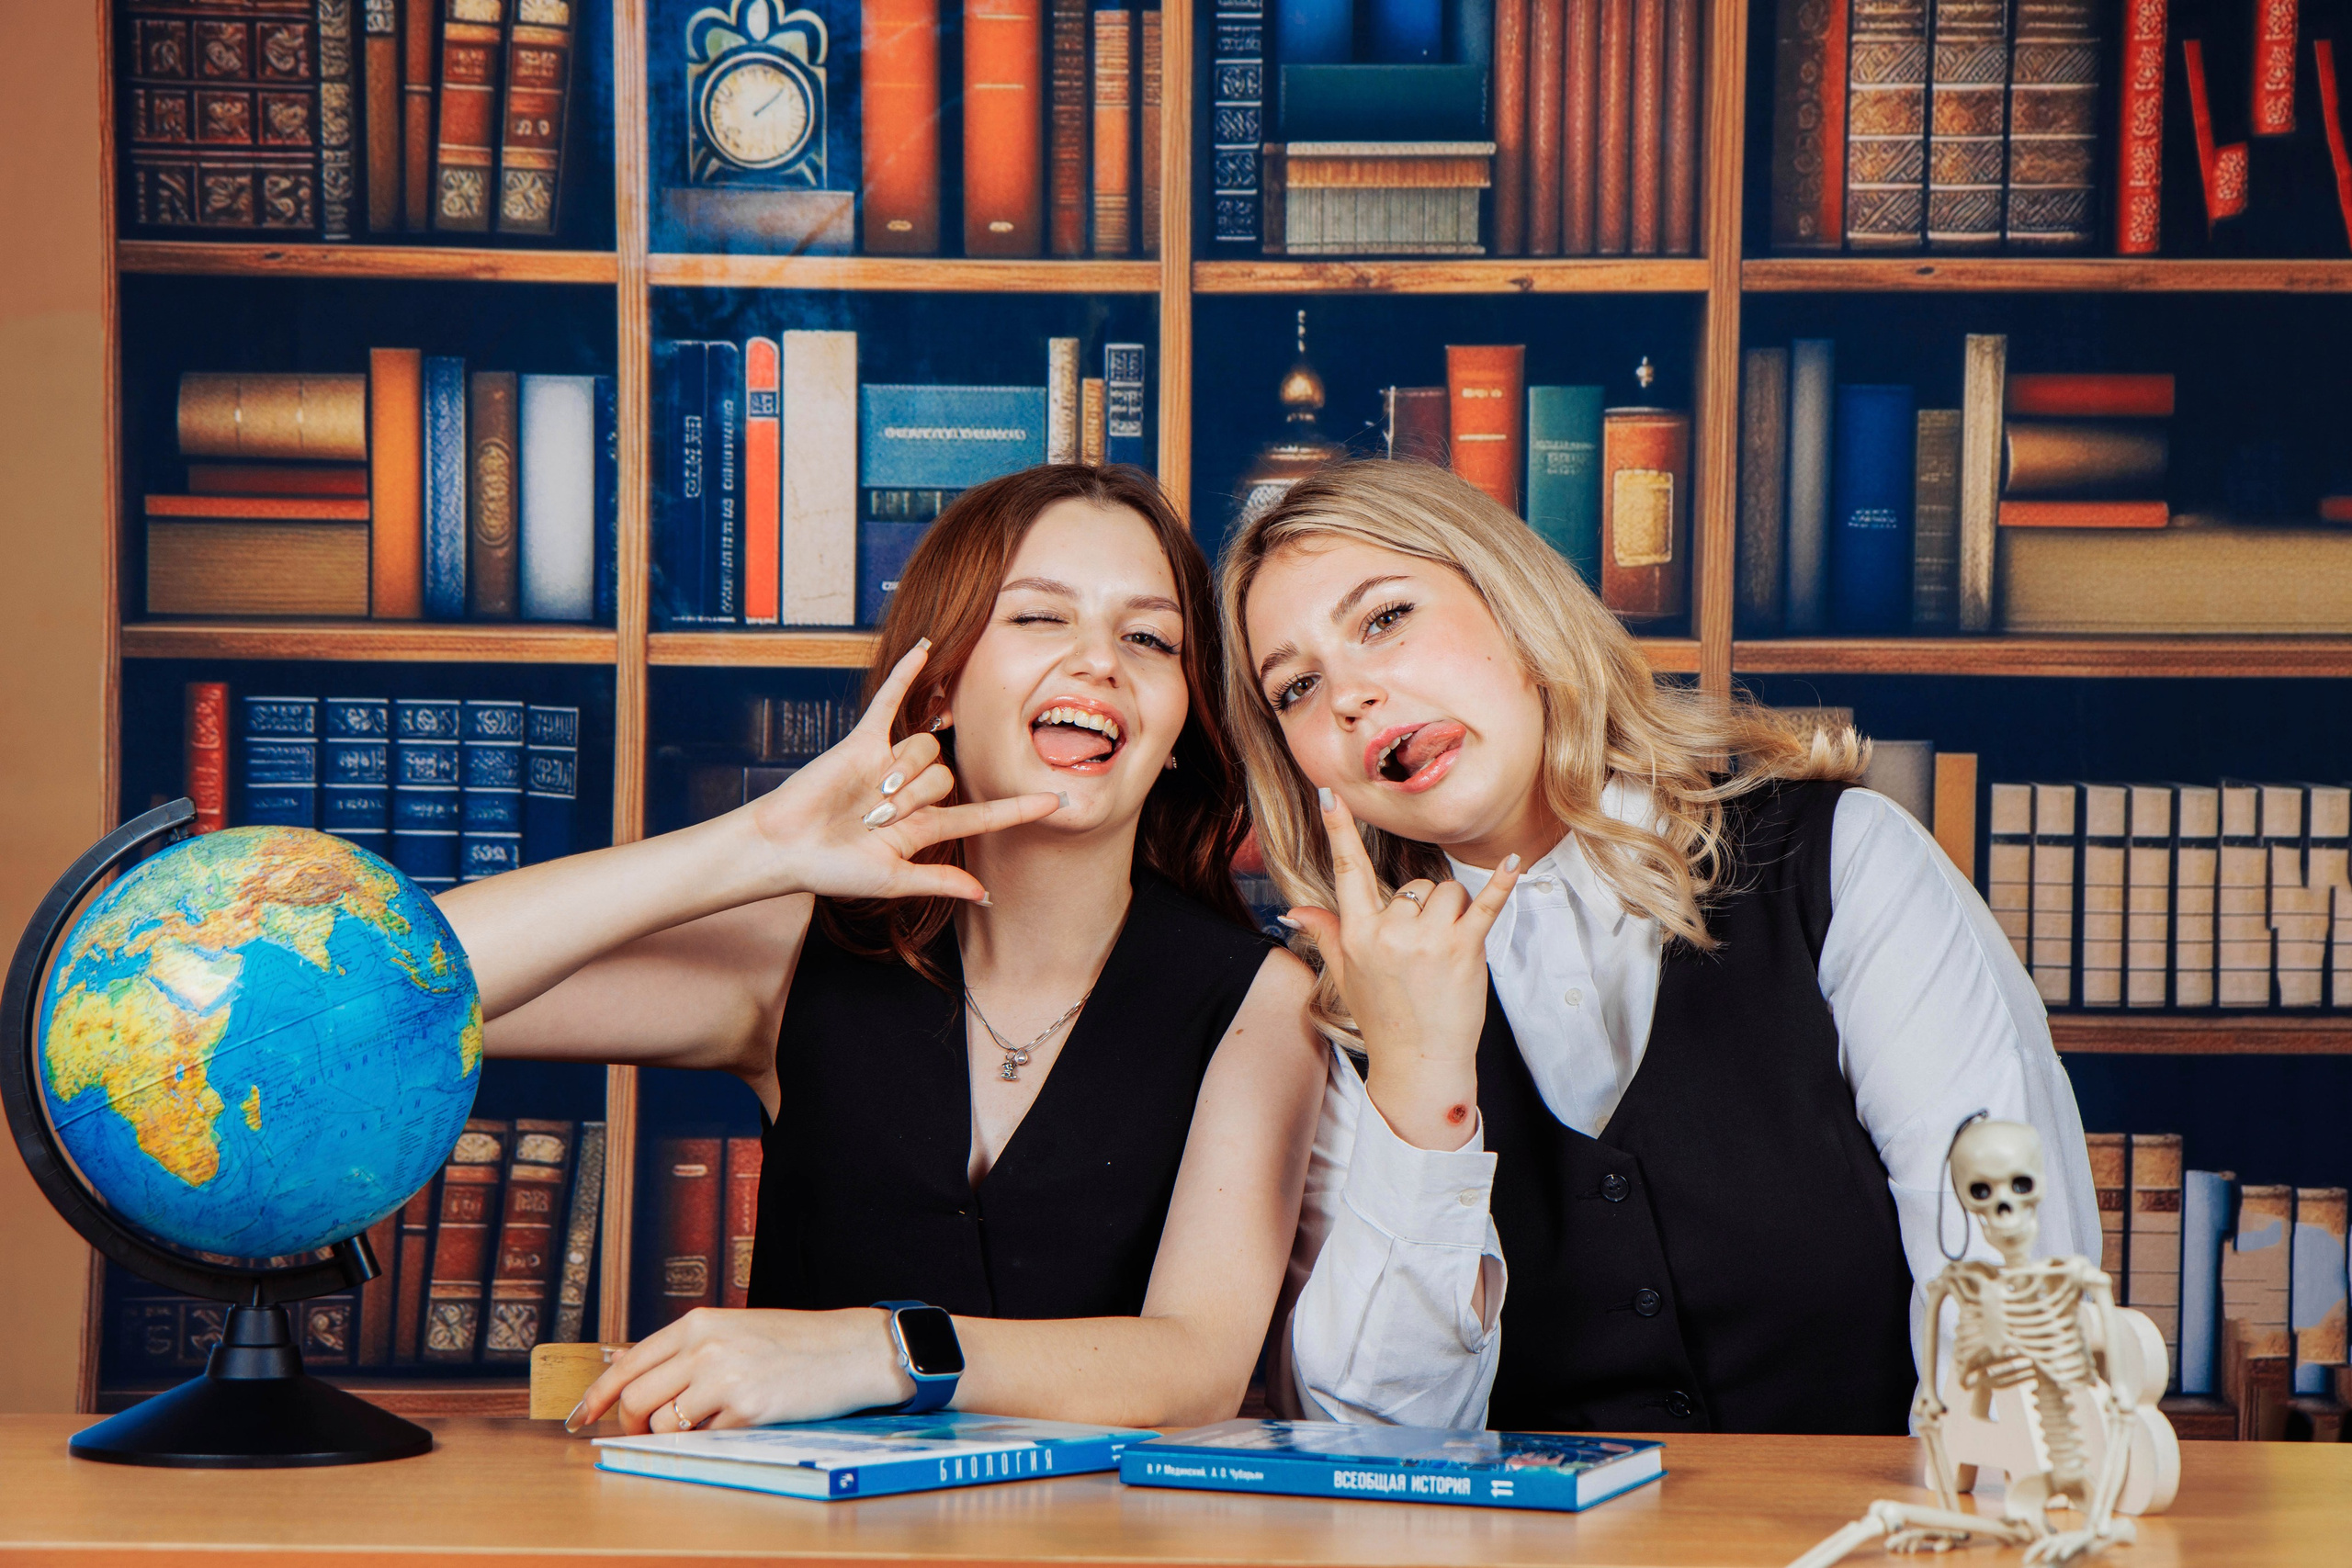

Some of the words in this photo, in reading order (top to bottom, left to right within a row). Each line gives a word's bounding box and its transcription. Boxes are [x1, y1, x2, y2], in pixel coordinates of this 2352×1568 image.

[339, 1097, 423, 1139] ОКЕАН
[939, 1448, 1053, 1482] БИОЛОГИЯ
[1333, 1470, 1407, 1493] ВСЕОБЩАЯ
[1410, 1474, 1472, 1495] ИСТОРИЯ
[1490, 1479, 1514, 1498] 11
